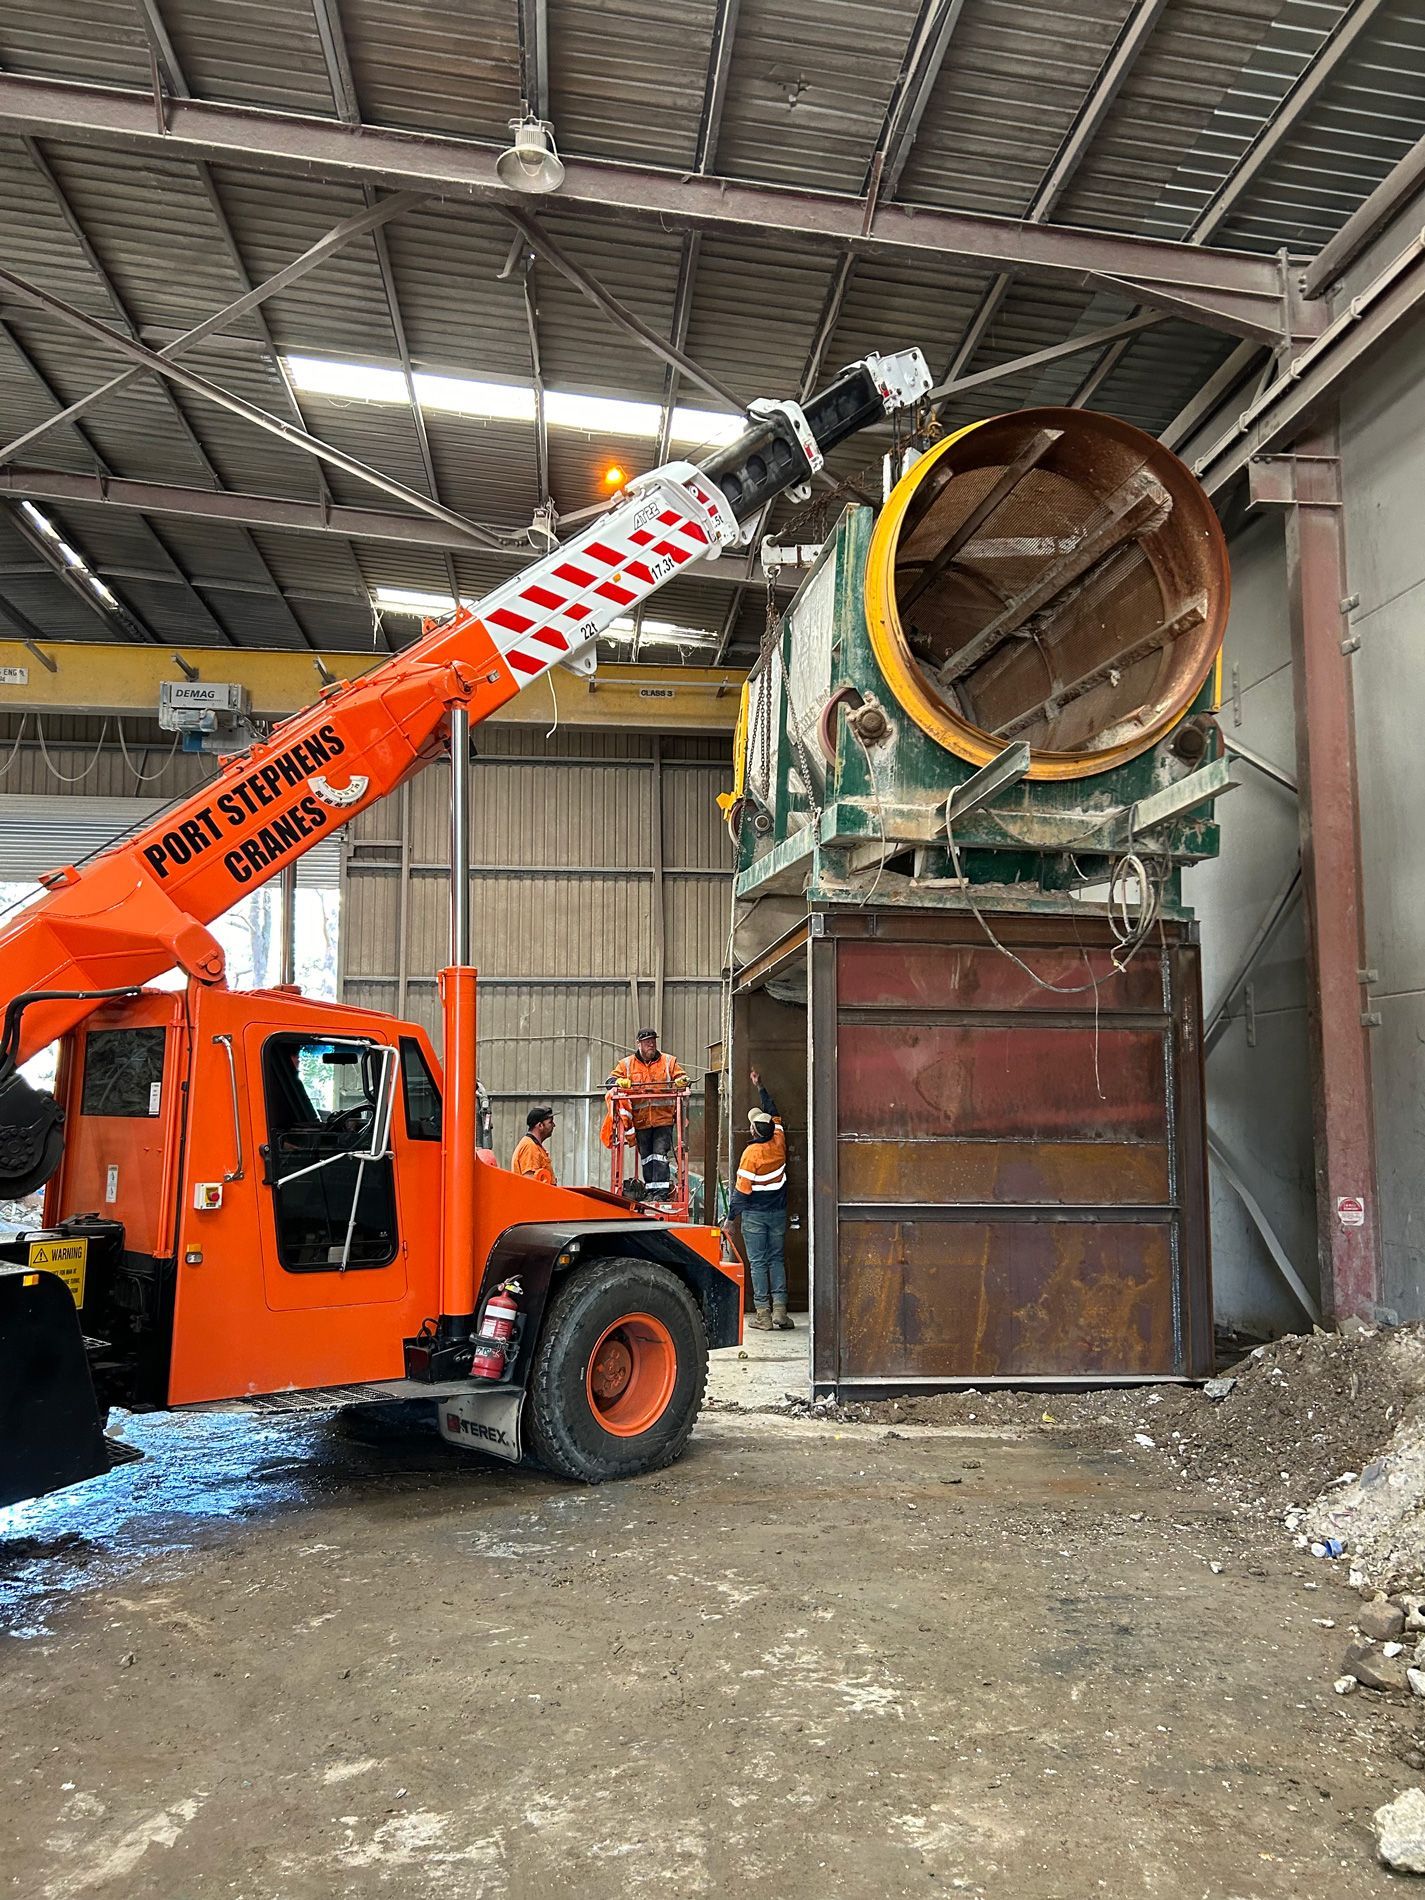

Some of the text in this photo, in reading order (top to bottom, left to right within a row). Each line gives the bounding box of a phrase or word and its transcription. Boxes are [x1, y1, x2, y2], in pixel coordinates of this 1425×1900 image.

[634, 502, 661, 530] AT22
[651, 556, 675, 580] 17.3t
[580, 621, 599, 641] 22t
[3, 668, 17, 676] ENG
[175, 689, 216, 699] DEMAG
[640, 689, 666, 697] CLASS
[143, 725, 345, 880] PORT STEPHENS
[224, 796, 327, 883] CRANES
[51, 1246, 82, 1261] WARNING
[460, 1419, 508, 1446] TEREX
